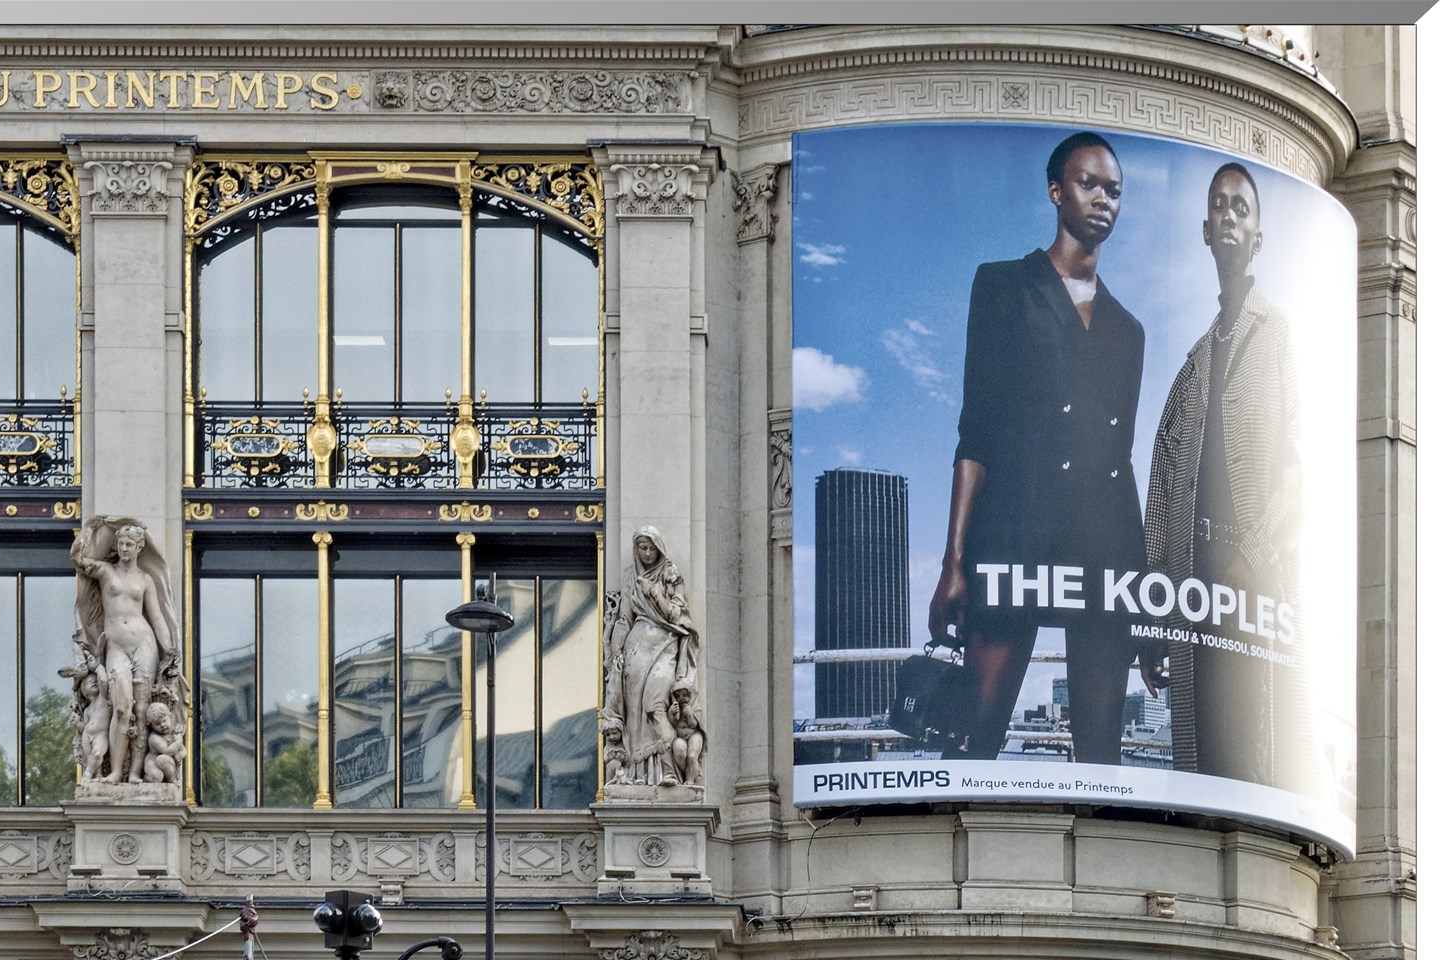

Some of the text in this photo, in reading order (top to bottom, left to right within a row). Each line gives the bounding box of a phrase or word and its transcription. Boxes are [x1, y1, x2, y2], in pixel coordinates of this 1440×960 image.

[33, 70, 340, 110] PRINTEMPS
[976, 563, 1297, 645] THE KOOPLES
[1131, 624, 1189, 642] MARI-LOU
[1191, 631, 1200, 644] &
[1201, 633, 1250, 657] YOUSSOU,
[813, 770, 1134, 795] PRINTEMPS Marque vendue au Printemps
